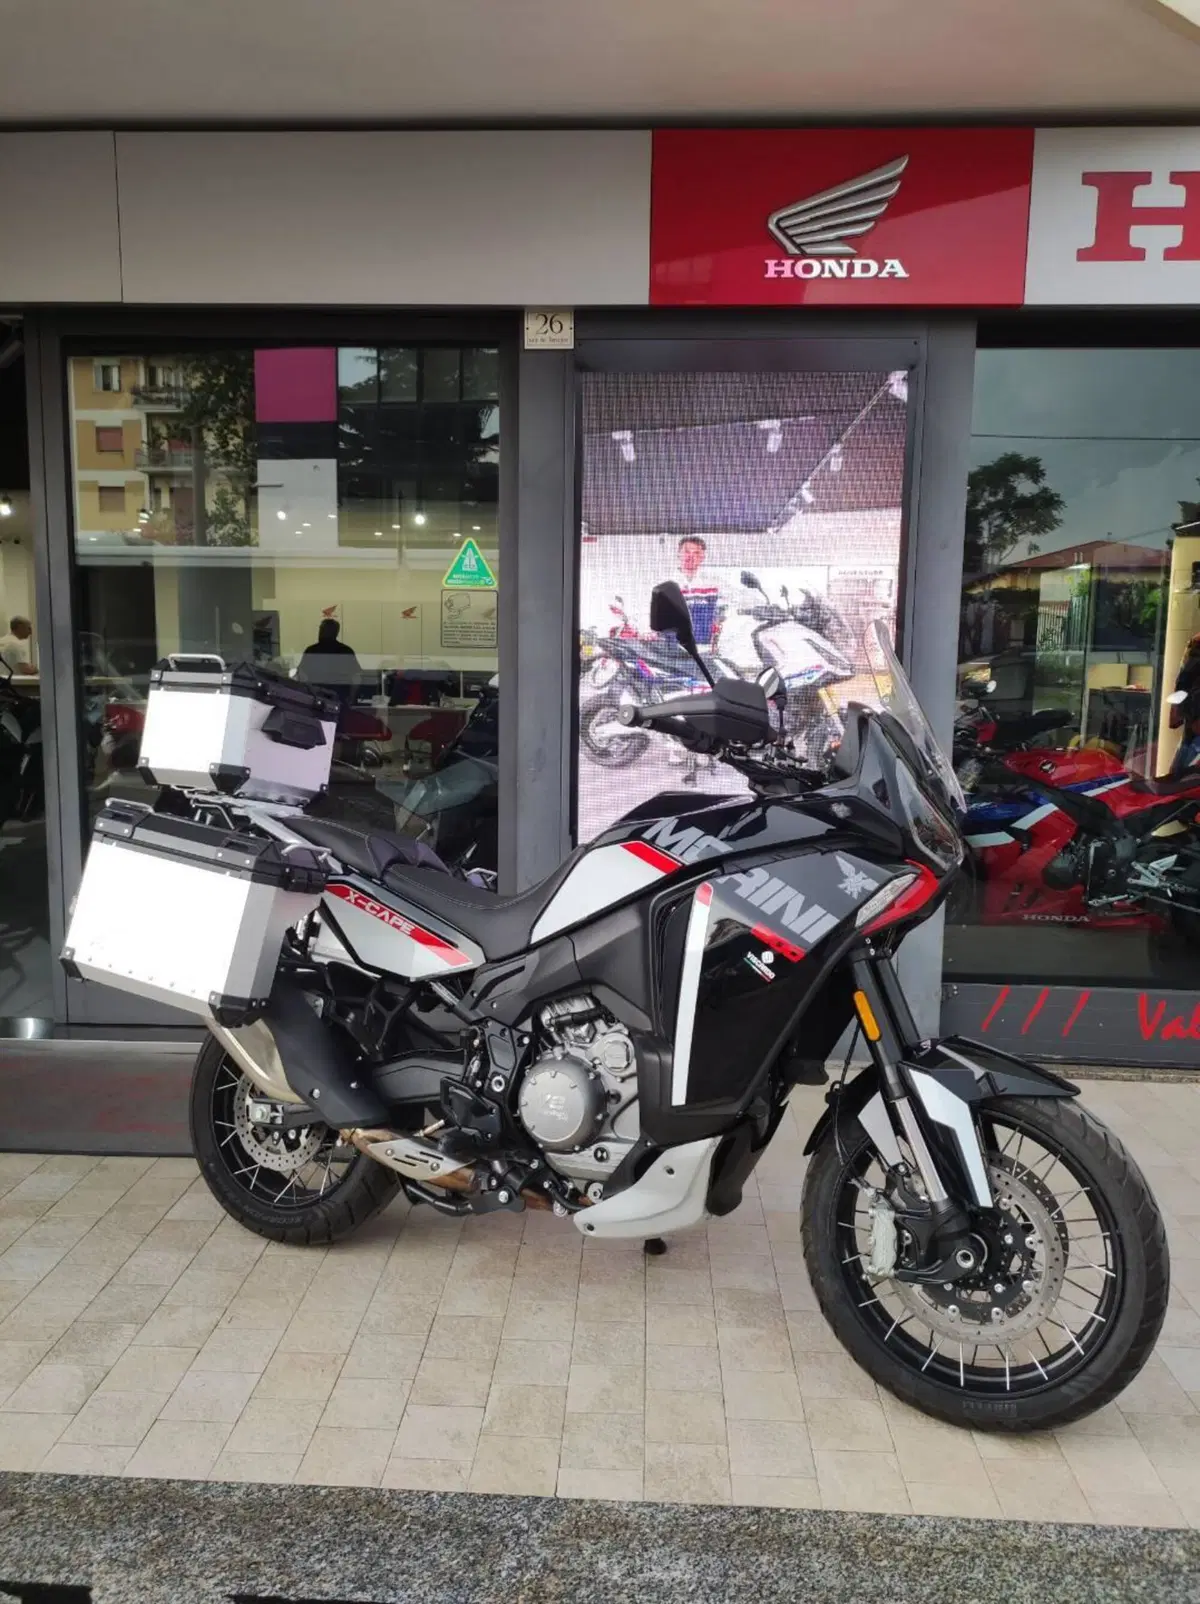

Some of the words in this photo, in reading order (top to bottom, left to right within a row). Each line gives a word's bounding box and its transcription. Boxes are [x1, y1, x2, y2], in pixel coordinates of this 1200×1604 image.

[764, 258, 910, 279] HONDA
[535, 313, 564, 335] 26
[344, 890, 415, 937] X-CAPE
[1022, 913, 1091, 923] HONDA
